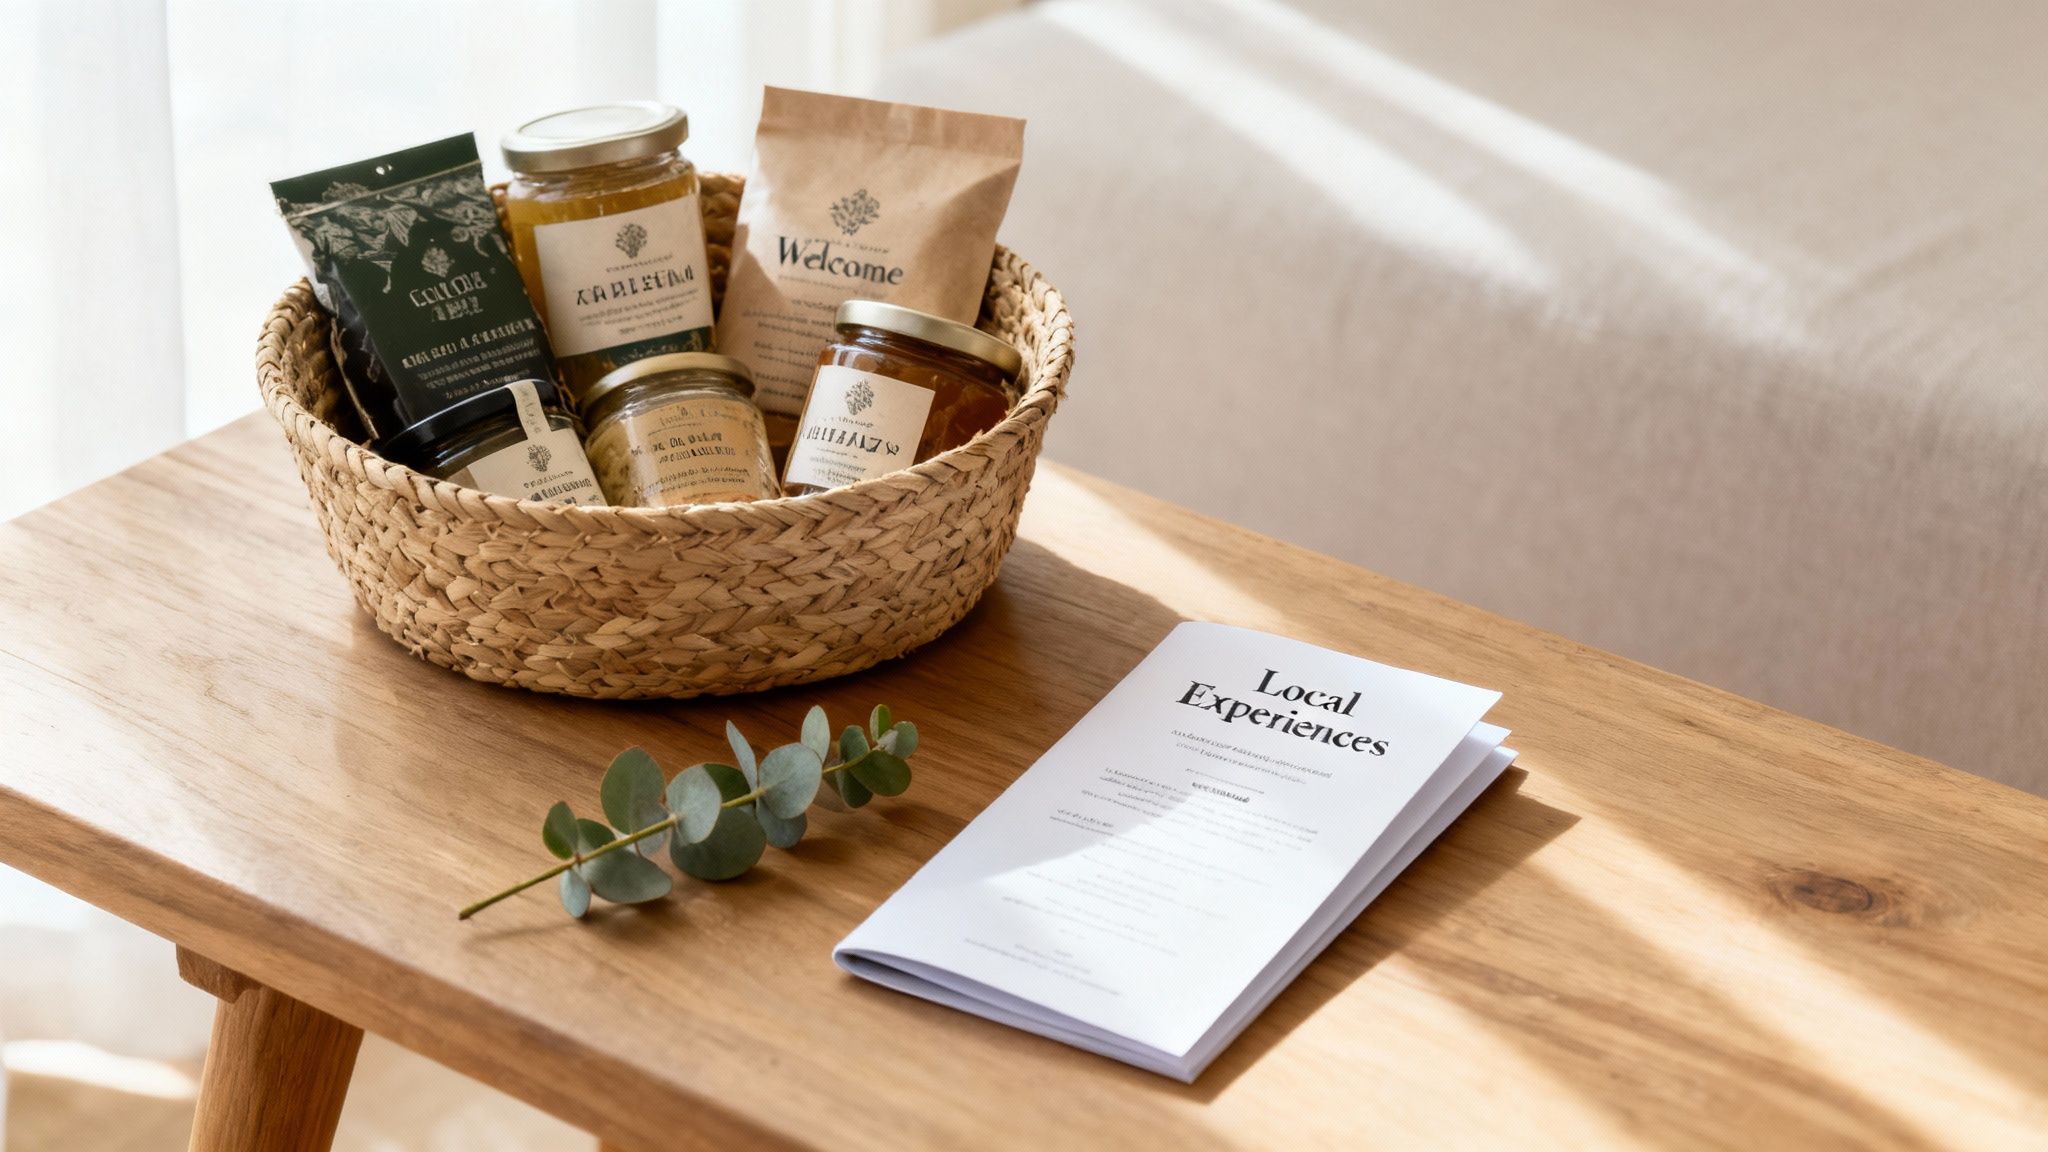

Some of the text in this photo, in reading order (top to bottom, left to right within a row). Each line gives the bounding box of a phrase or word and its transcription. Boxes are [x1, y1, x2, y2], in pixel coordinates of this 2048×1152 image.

[777, 235, 904, 285] Welcome
[1252, 668, 1362, 717] Local
[1176, 680, 1389, 756] Experiences
